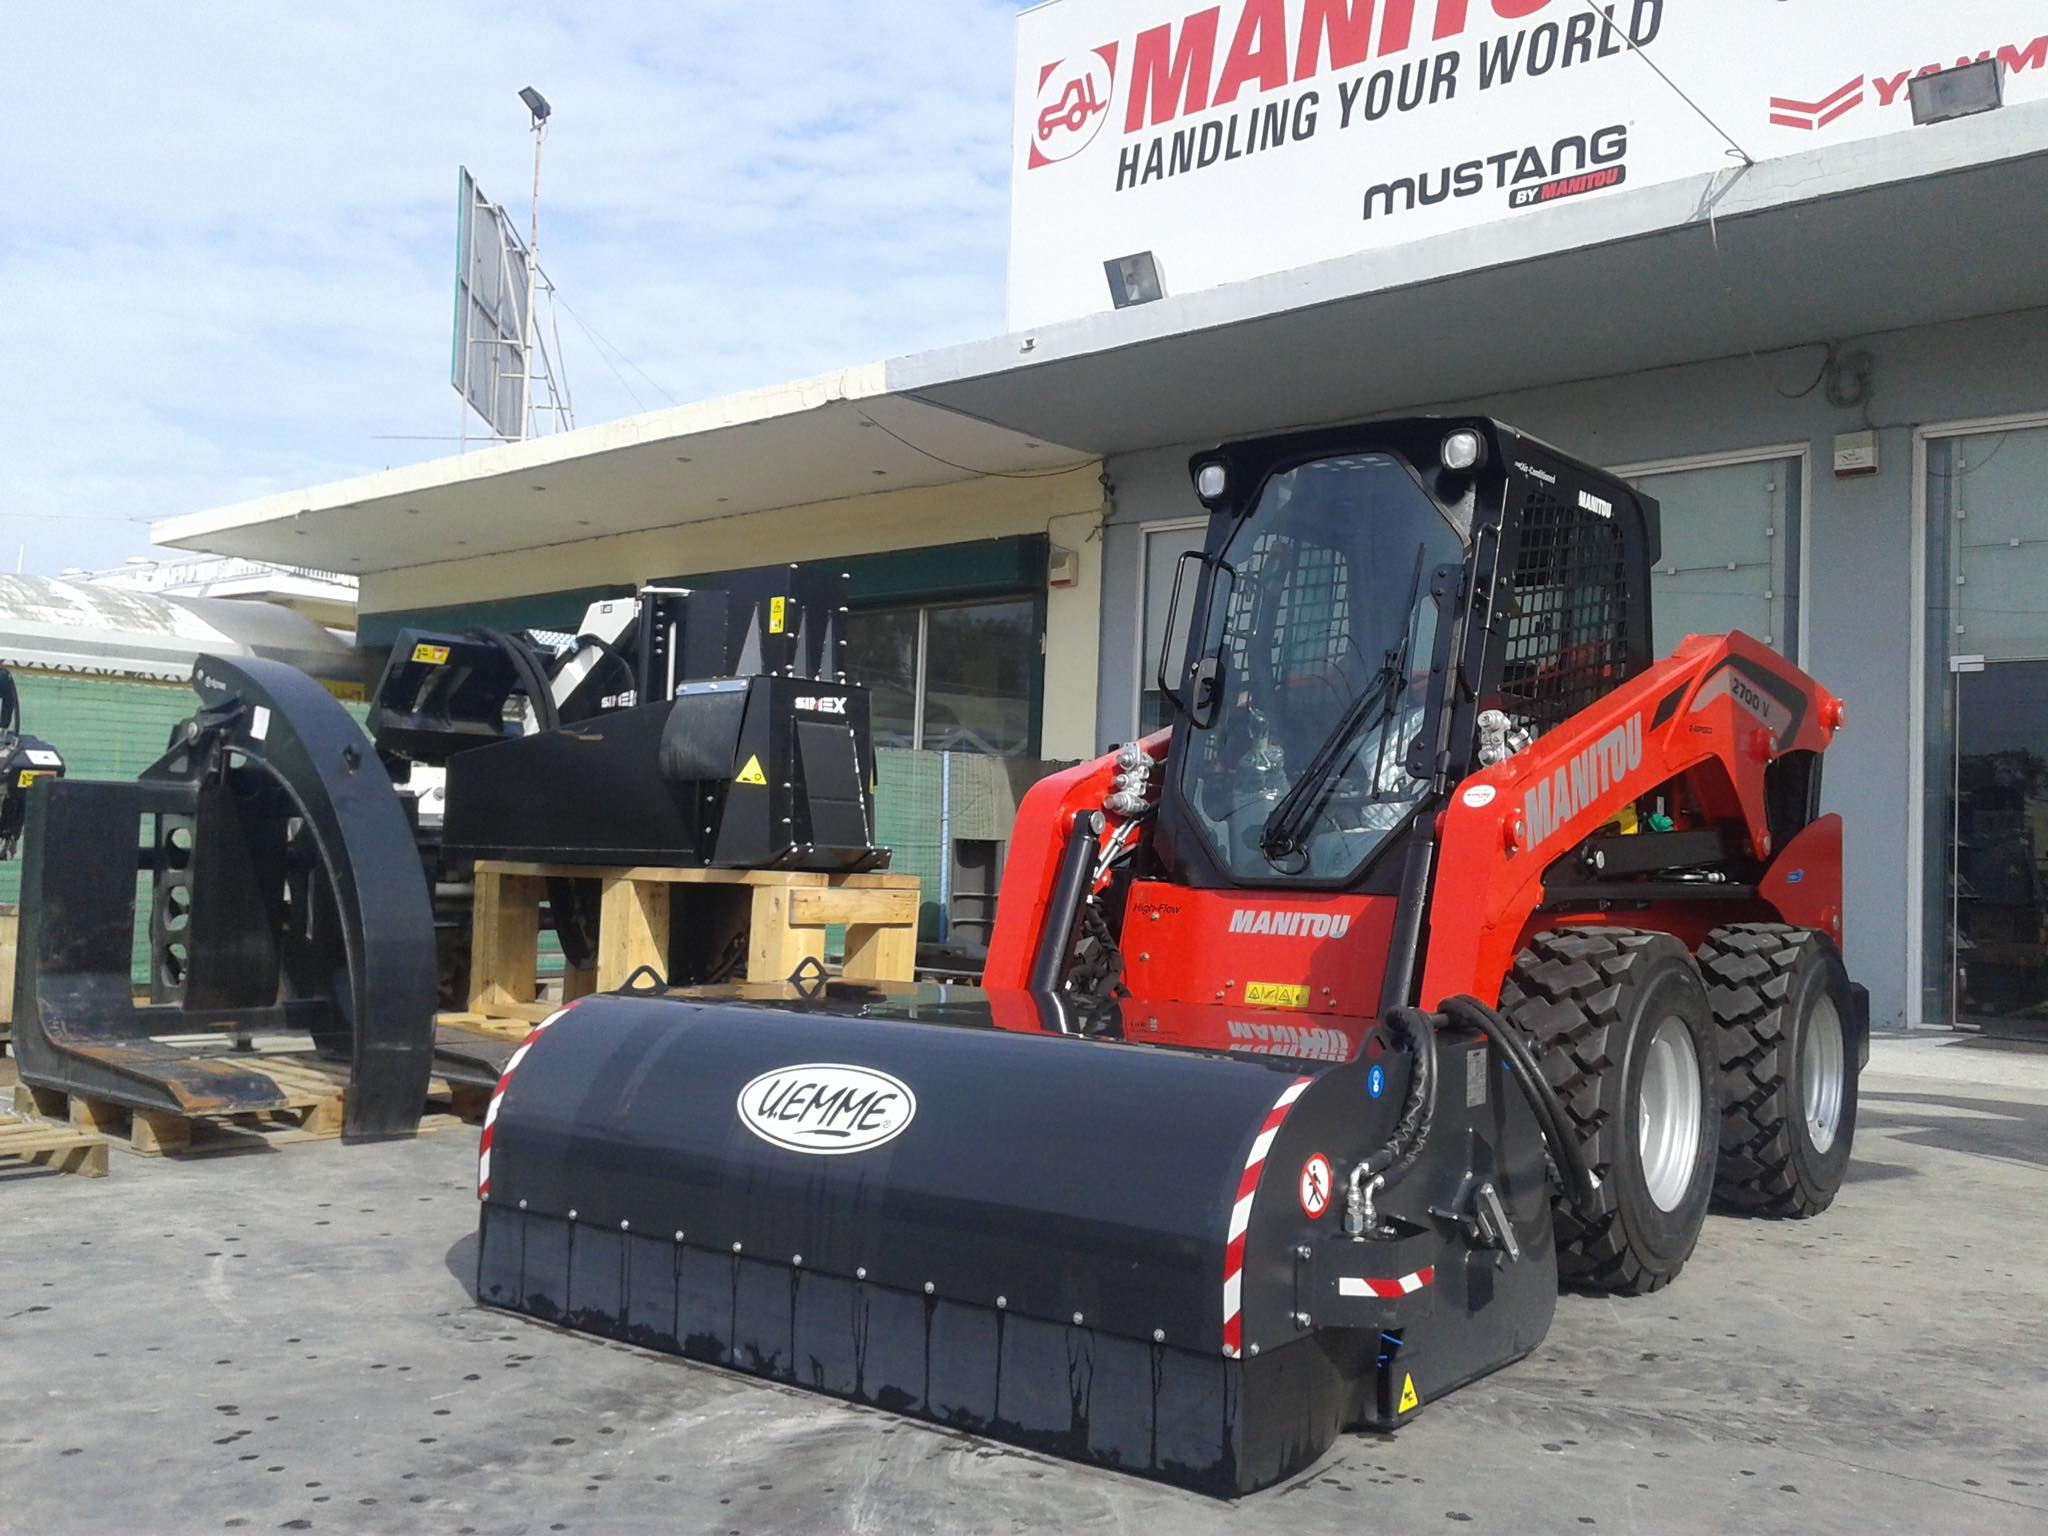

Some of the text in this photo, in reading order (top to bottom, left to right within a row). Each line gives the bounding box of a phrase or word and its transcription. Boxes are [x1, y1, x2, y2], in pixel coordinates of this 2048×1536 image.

[1115, 0, 1664, 192] HANDLING YOUR WORLD
[1515, 167, 1619, 205] BY MANITOU
[1578, 490, 1613, 519] MANITOU
[794, 696, 848, 715] SIMEX
[1732, 677, 1770, 718] 2700 V
[1524, 711, 1643, 853] MANITOU
[1229, 909, 1351, 939] MANITOU
